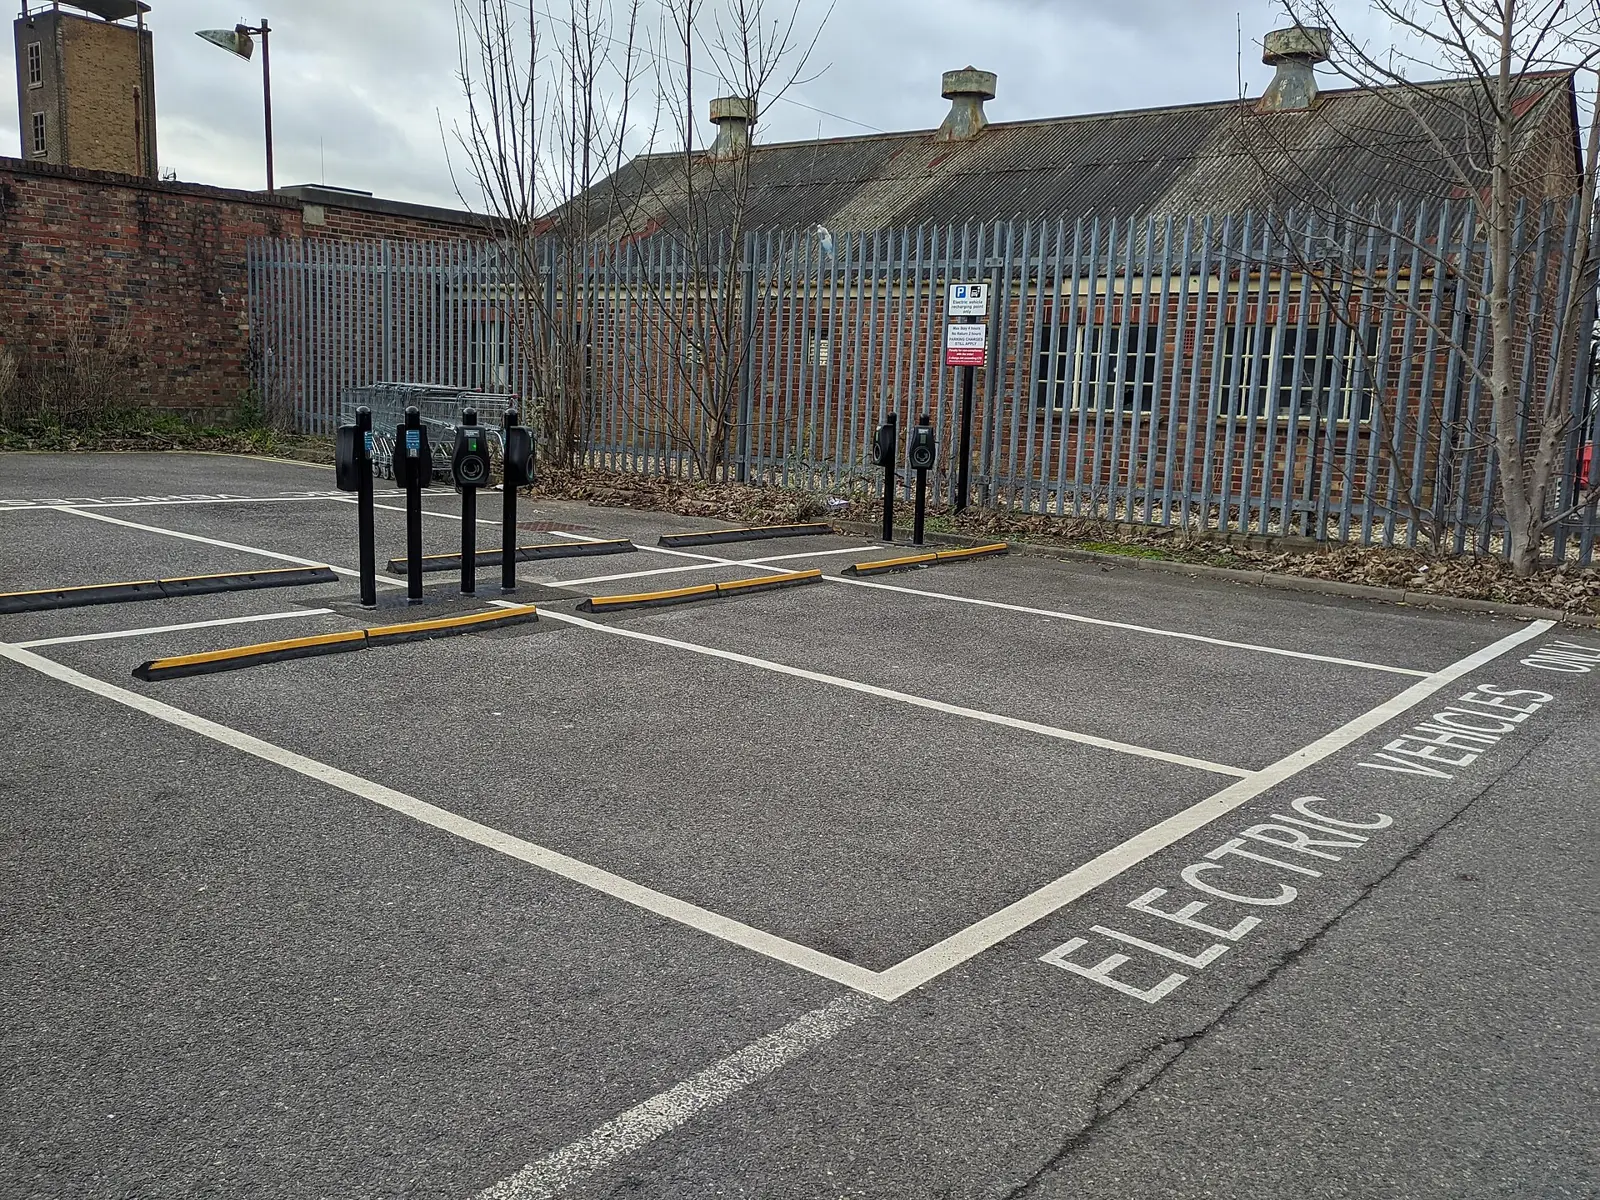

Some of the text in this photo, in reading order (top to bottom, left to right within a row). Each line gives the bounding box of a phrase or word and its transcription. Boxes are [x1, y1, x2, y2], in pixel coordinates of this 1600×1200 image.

[1038, 640, 1600, 1004] ELECTRIC VEHICLES ONLY
